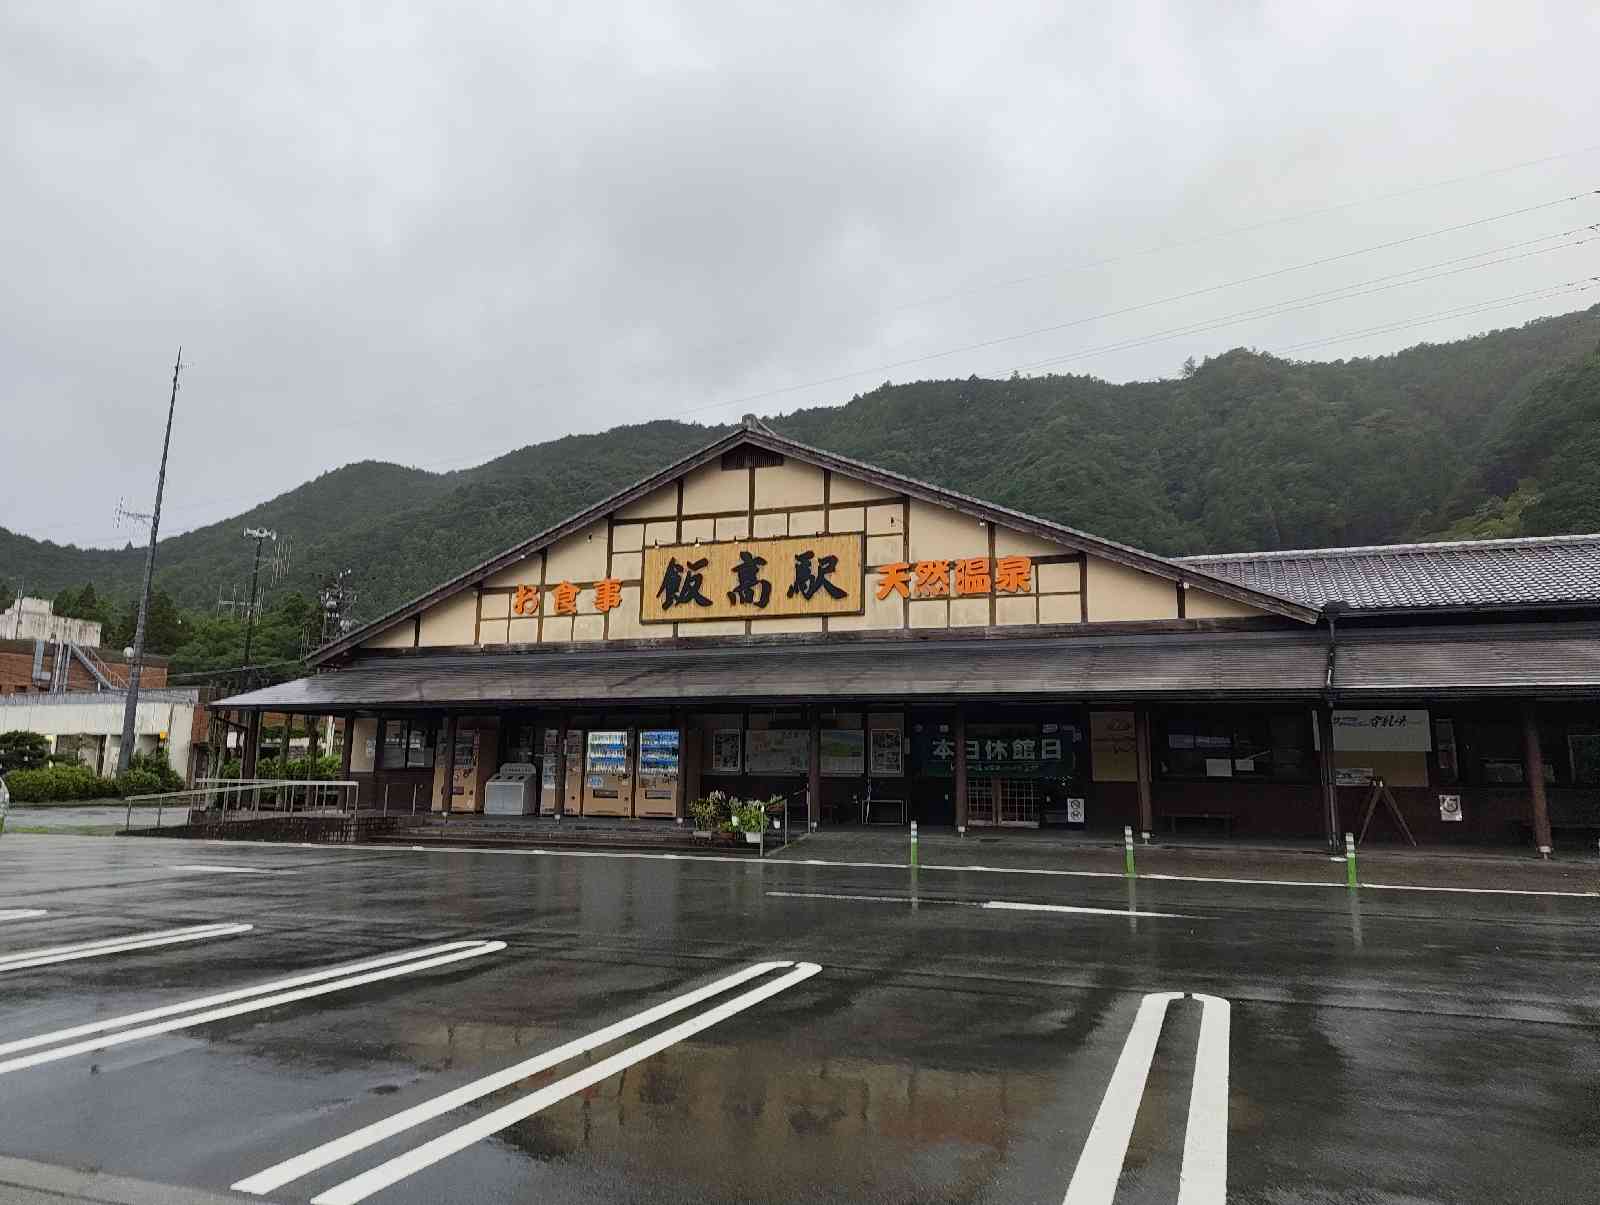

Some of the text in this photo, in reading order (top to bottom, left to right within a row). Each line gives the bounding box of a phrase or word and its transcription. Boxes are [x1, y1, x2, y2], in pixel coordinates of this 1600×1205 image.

[512, 578, 623, 615] お食事
[657, 550, 849, 609] 飯高駅
[876, 556, 1032, 599] 天然温泉
[932, 738, 1062, 760] 本日休館日
